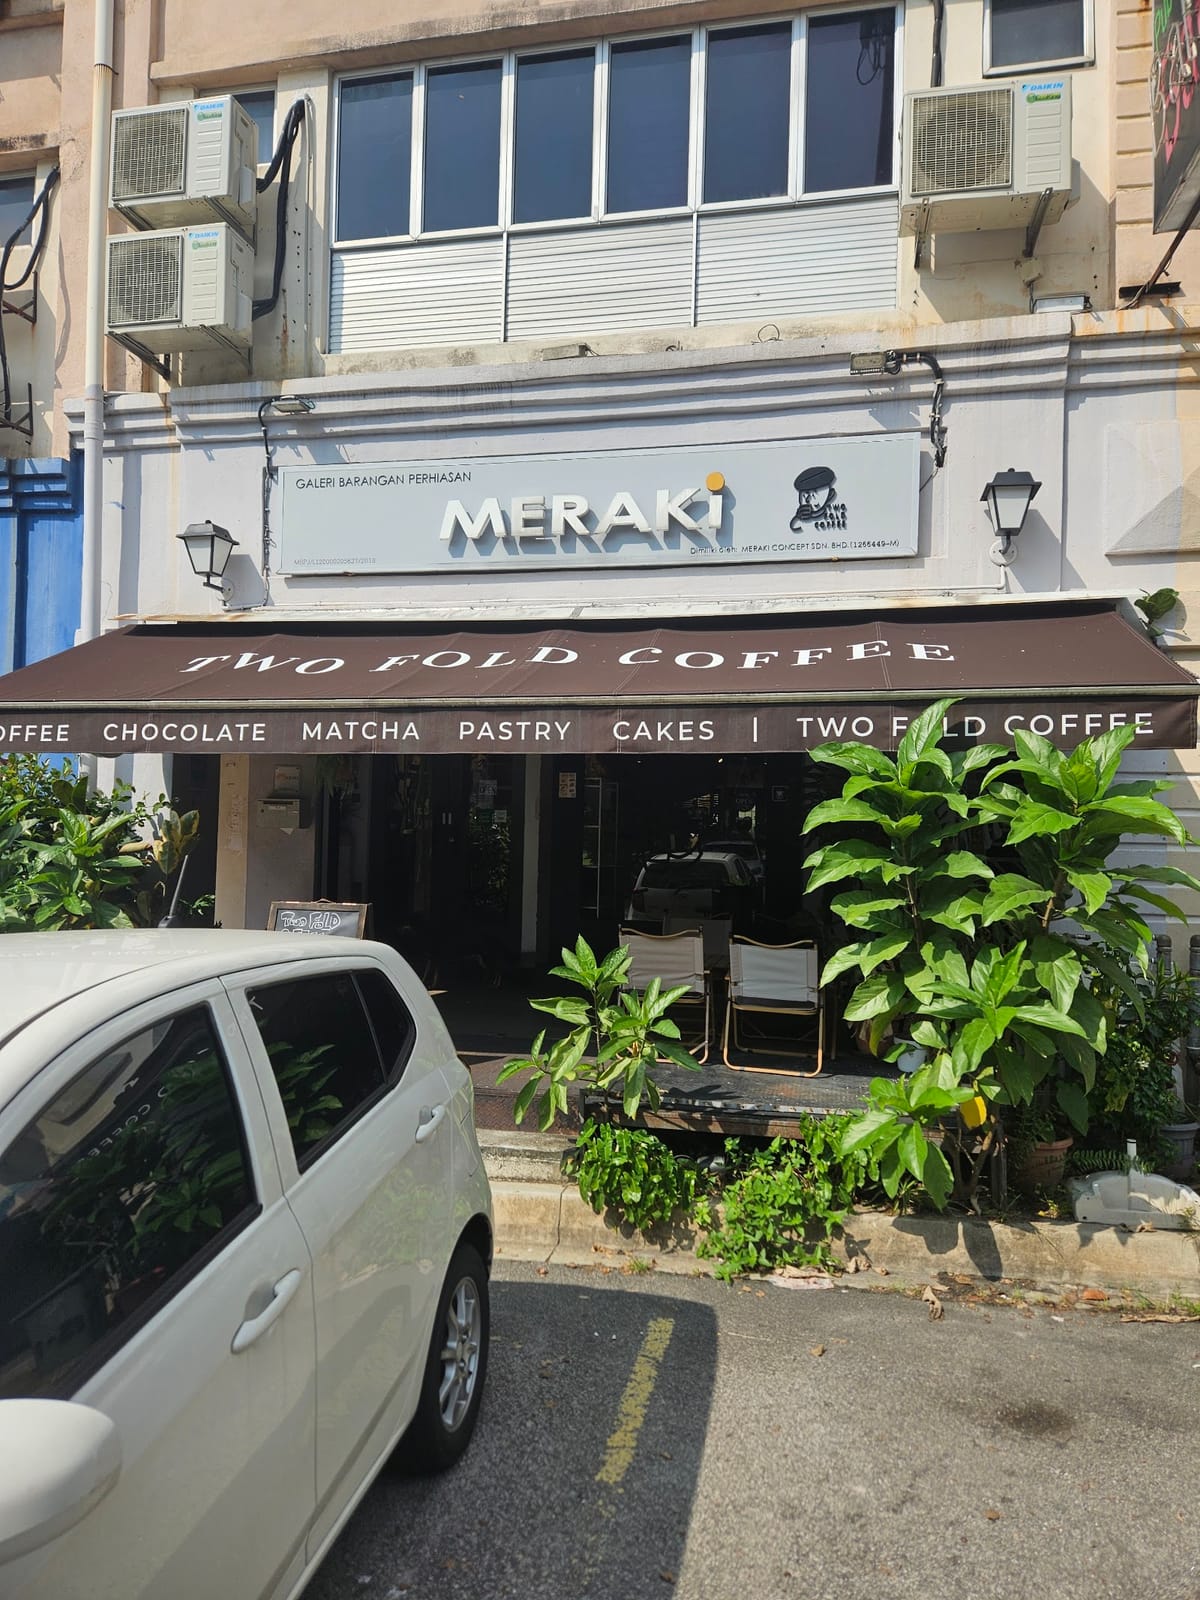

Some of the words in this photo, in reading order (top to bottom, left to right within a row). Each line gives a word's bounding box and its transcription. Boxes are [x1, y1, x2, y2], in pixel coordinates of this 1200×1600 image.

[1030, 82, 1063, 91] DAIKIN
[295, 478, 335, 489] GALERI
[339, 474, 404, 487] BARANGAN
[408, 471, 472, 484] PERHIASAN
[741, 544, 769, 553] MERAKI
[771, 542, 809, 552] CONCEPT
[179, 652, 345, 675] TWO
[369, 646, 579, 672] FOLD
[618, 640, 955, 669] COFFEE
[103, 722, 266, 742] CHOCOLATE
[302, 721, 421, 741] MATCHA
[459, 721, 571, 741] PASTRY
[613, 720, 715, 741] CAKES
[796, 716, 874, 738] TWO
[892, 715, 986, 737] FLD
